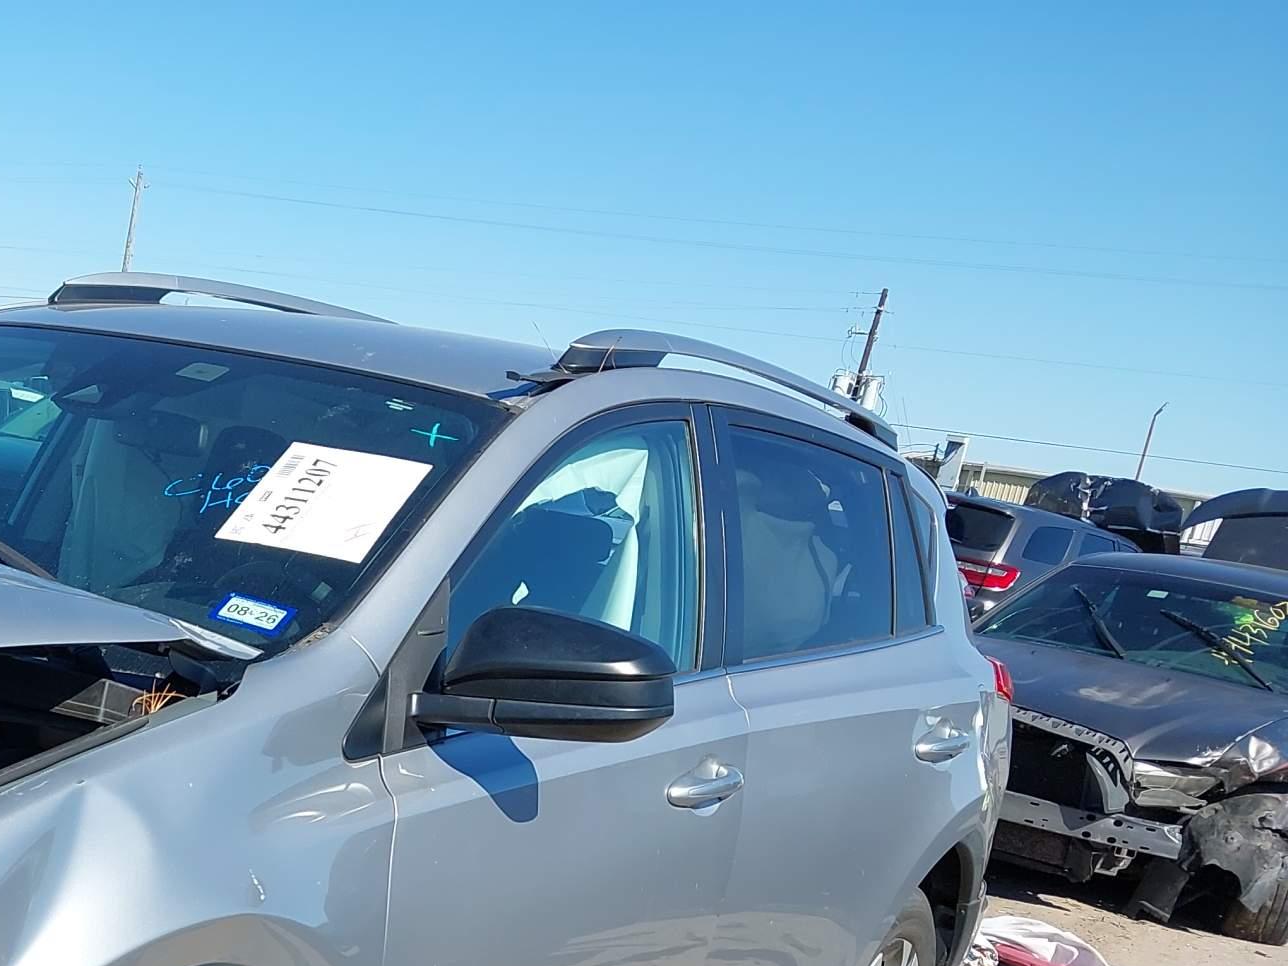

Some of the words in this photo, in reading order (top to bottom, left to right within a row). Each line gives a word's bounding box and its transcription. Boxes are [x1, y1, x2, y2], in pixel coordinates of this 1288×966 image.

[261, 458, 338, 534] 44311207
[226, 603, 250, 616] 08
[254, 610, 279, 625] 26
